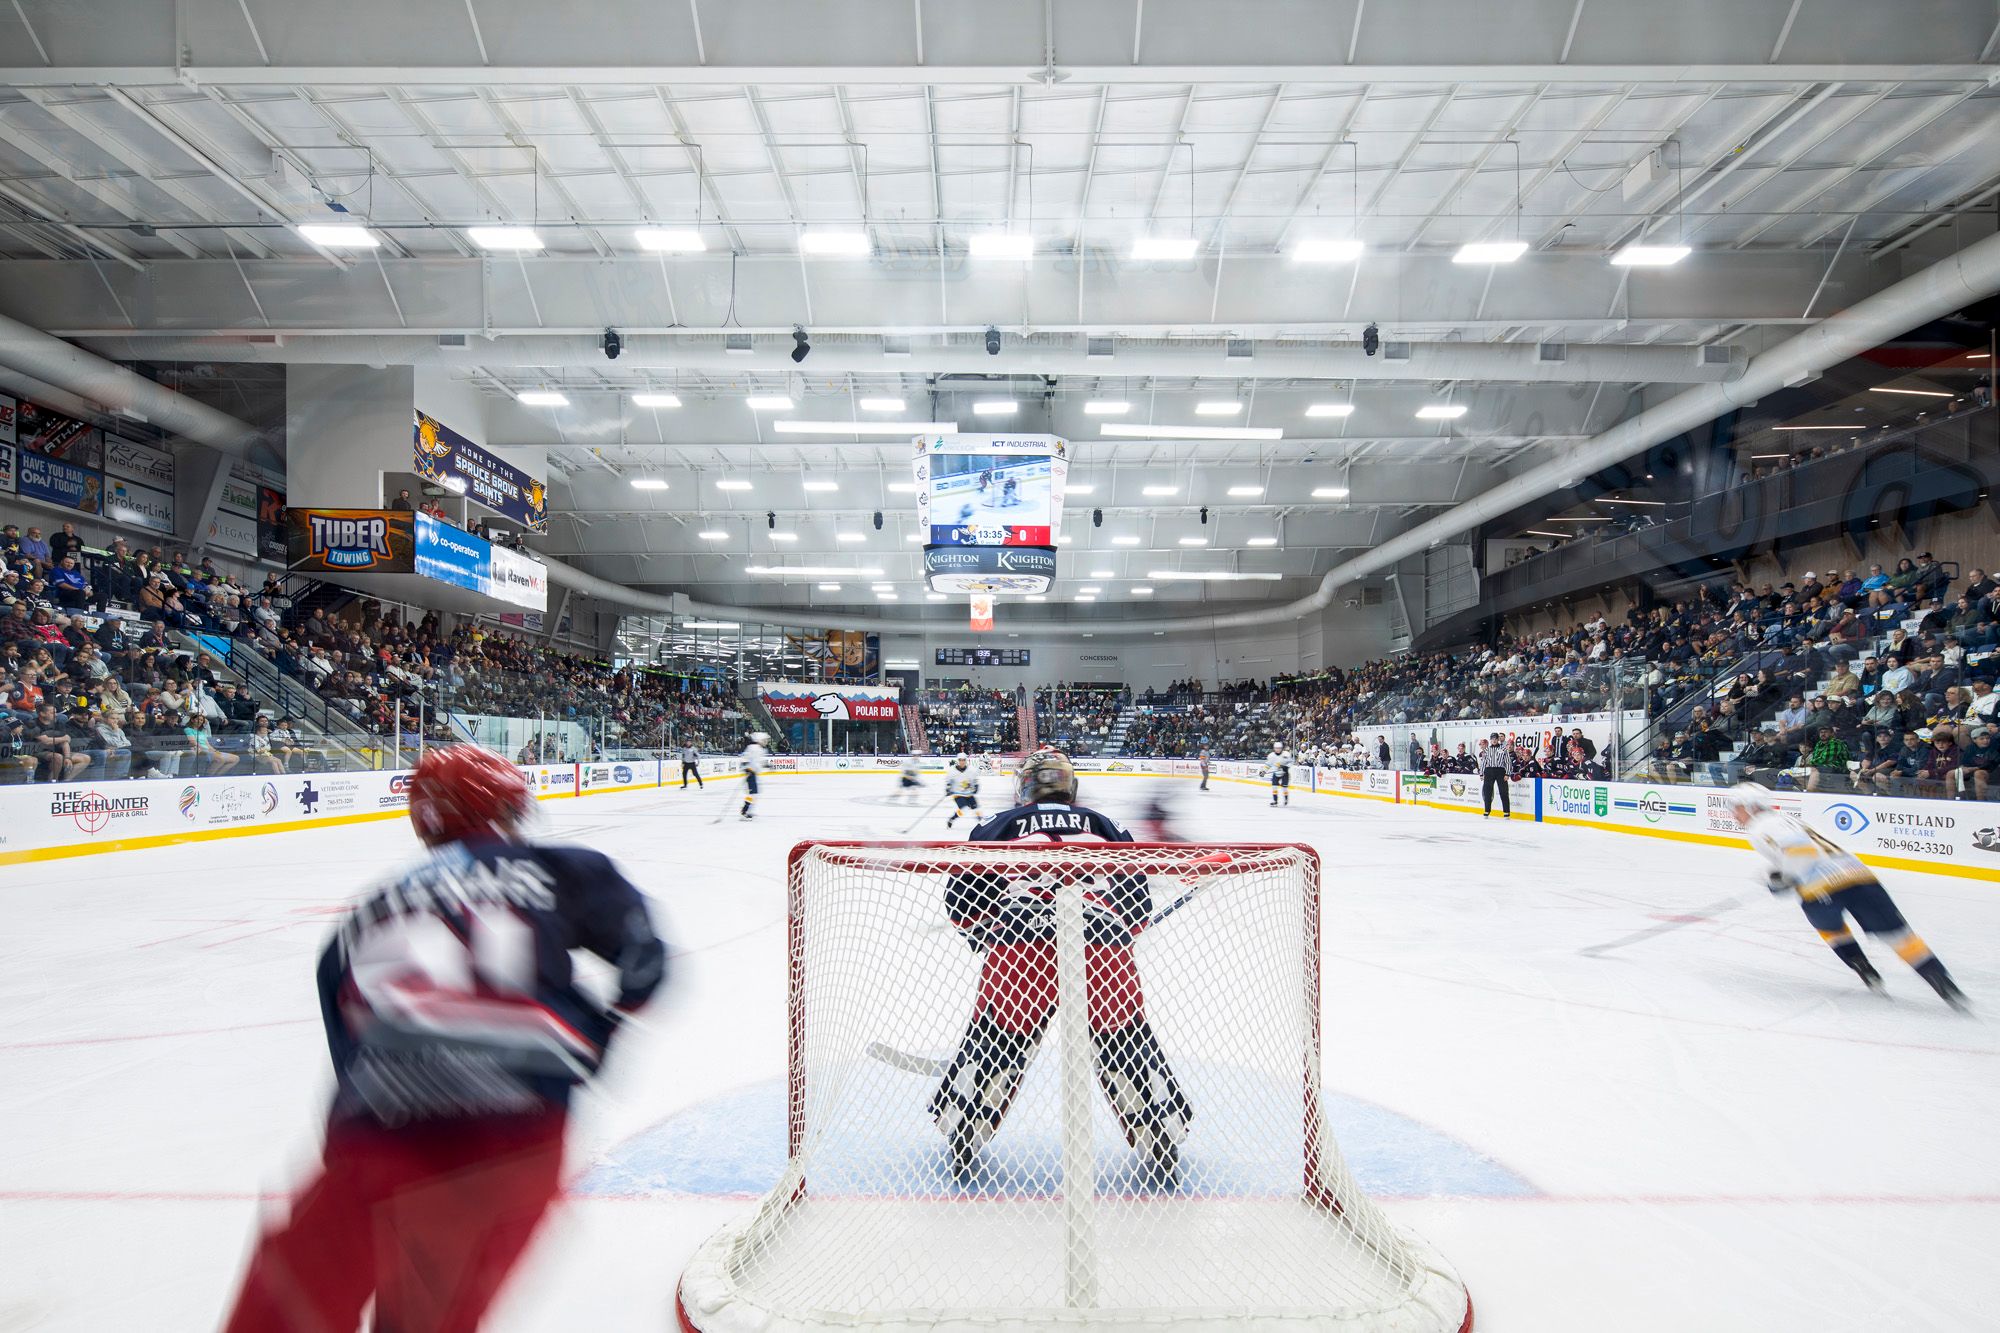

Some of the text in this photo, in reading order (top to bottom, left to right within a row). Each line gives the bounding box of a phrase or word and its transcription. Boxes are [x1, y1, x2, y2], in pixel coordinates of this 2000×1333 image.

[23, 455, 46, 472] HAVE
[48, 462, 64, 478] YOU
[66, 468, 82, 484] HAD
[106, 455, 172, 482] INDUSTRIES
[461, 445, 514, 480] HOME OF THE
[455, 455, 518, 499] SPRUCE GROVE
[54, 478, 84, 496] TODAY?
[473, 479, 503, 504] SAINTS
[107, 491, 172, 520] BrokerLink
[220, 526, 256, 543] LEGACY
[312, 518, 386, 554] TUBER
[952, 529, 1026, 541] 0 13:35 0
[440, 538, 480, 559] co-operators
[332, 552, 369, 564] TOWING
[926, 552, 980, 571] KNIGHTON
[996, 551, 1054, 570] KNIGHTON
[789, 704, 808, 715] Spas
[856, 705, 878, 716] POLAR
[881, 706, 894, 716] DEN
[551, 774, 561, 784] AUTO
[562, 773, 574, 784] PARTS
[53, 791, 82, 801] THE
[379, 795, 409, 804] CONSTRU
[1562, 785, 1591, 800] Grove
[51, 797, 148, 815] BEER HUNTER
[1562, 800, 1591, 814] Dental
[1640, 800, 1666, 812] PACE
[1708, 796, 1721, 808] DAN
[1708, 810, 1719, 818] REAL
[1876, 812, 1955, 828] WESTLAND
[1016, 813, 1091, 837] ZAHARA
[1912, 828, 1935, 838] CARE
[1877, 838, 1953, 855] 780-962-3320
